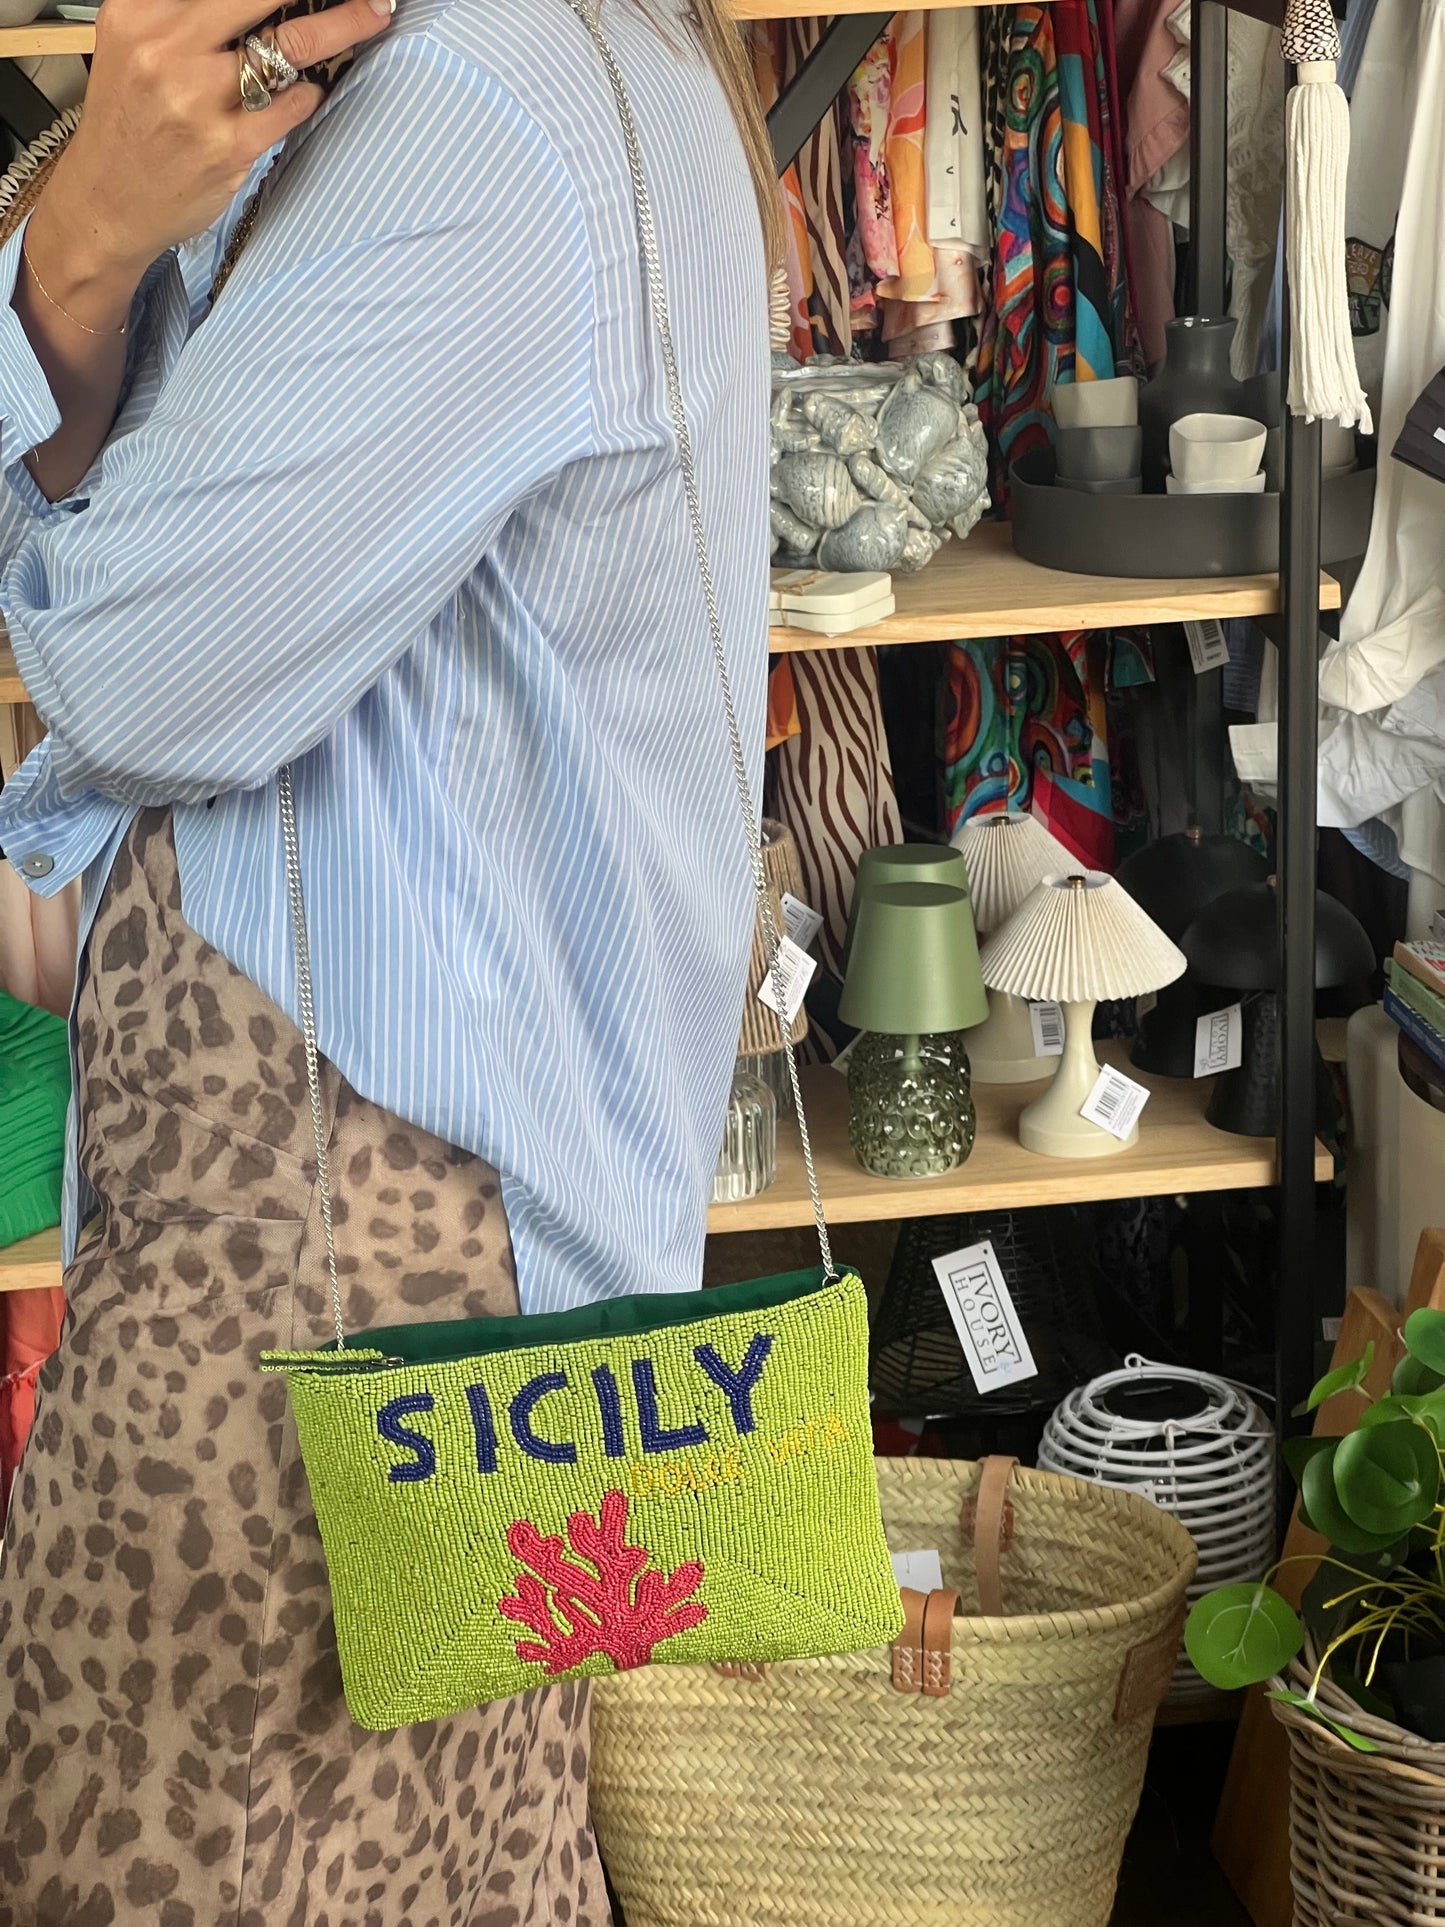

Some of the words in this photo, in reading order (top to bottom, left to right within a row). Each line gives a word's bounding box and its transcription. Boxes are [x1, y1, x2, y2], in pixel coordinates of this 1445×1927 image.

[955, 1277, 996, 1366] HOUSE
[968, 1272, 1014, 1357] IVORY
[377, 1334, 773, 1482] SICILY
[630, 1446, 742, 1496] DOLCE
[767, 1414, 844, 1465] VITA
